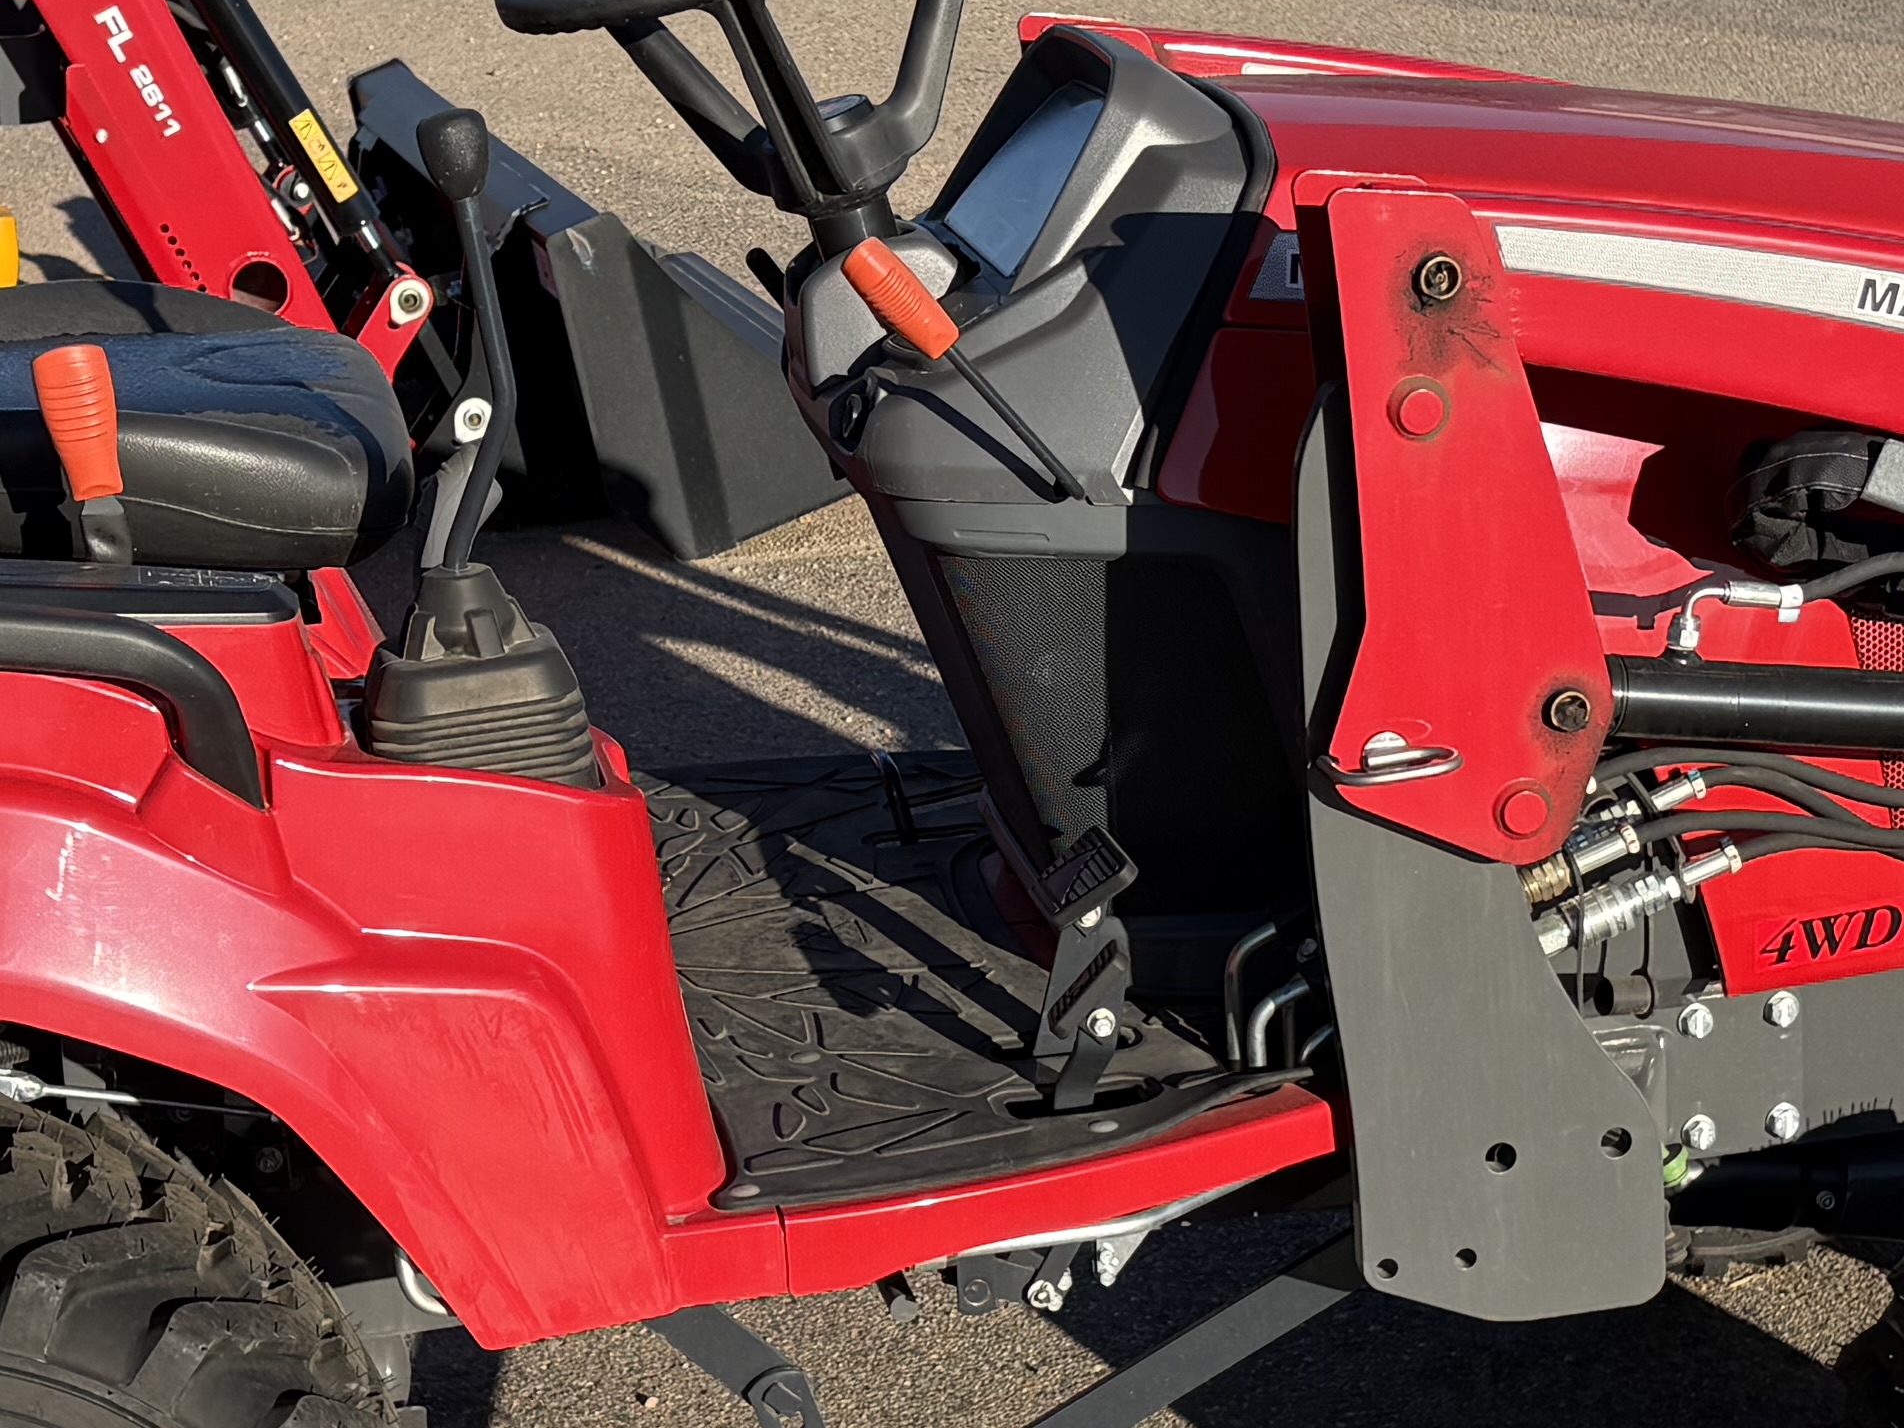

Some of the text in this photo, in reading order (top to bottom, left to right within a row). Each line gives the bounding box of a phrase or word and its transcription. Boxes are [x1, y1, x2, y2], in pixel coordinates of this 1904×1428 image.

[93, 5, 181, 137] FL 2611
[1758, 903, 1903, 965] 4WD
